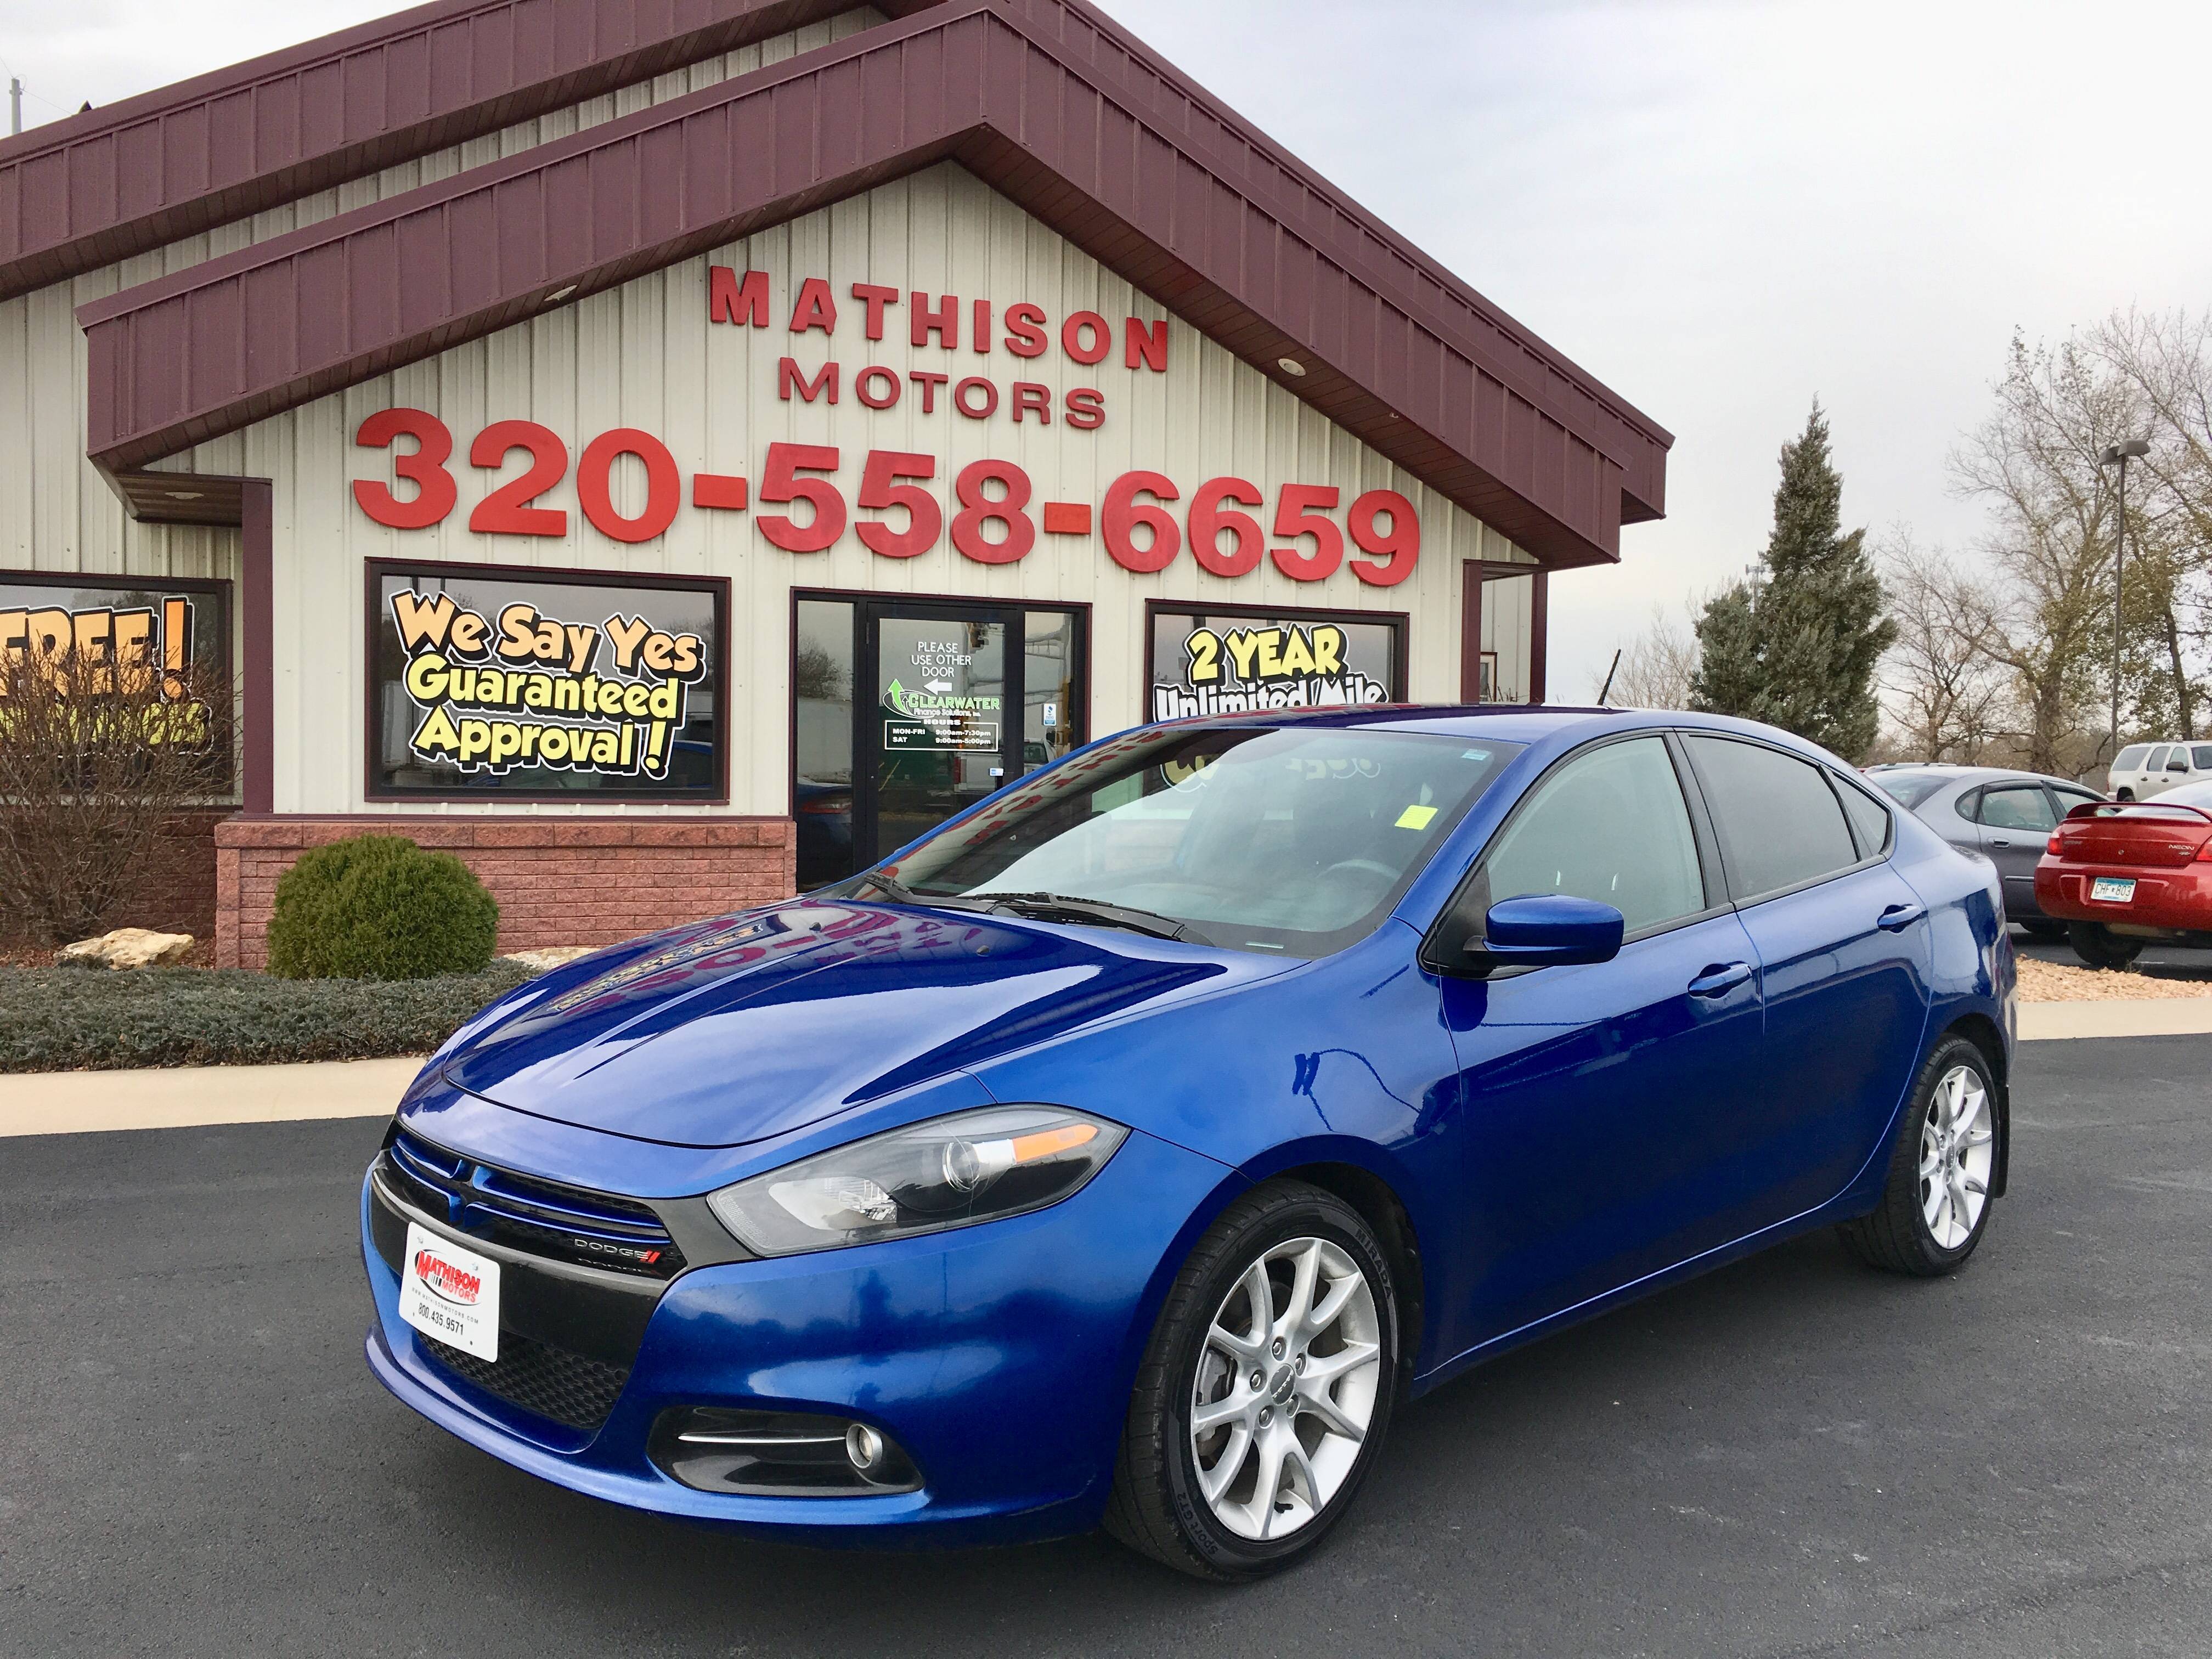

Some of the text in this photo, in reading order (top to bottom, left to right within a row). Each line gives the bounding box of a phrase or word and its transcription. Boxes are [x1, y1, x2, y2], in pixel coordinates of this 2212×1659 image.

[709, 264, 1169, 372] MATHISON
[779, 356, 1105, 430] MOTORS
[352, 407, 1421, 587] 320-558-6659
[395, 593, 697, 673] We Say Yes
[917, 641, 958, 653] PLEASE
[1188, 624, 1340, 681] 2 YEAR
[911, 654, 972, 665] USE OTHER
[922, 667, 955, 677] DOOR
[408, 654, 681, 718] Guaranteed
[909, 694, 1000, 710] CLEARWATER
[574, 1239, 649, 1260] DODGE
[416, 1250, 481, 1295] MATHISON
[441, 1280, 476, 1304] MOTORS
[418, 1302, 464, 1336] 800.435.9571
